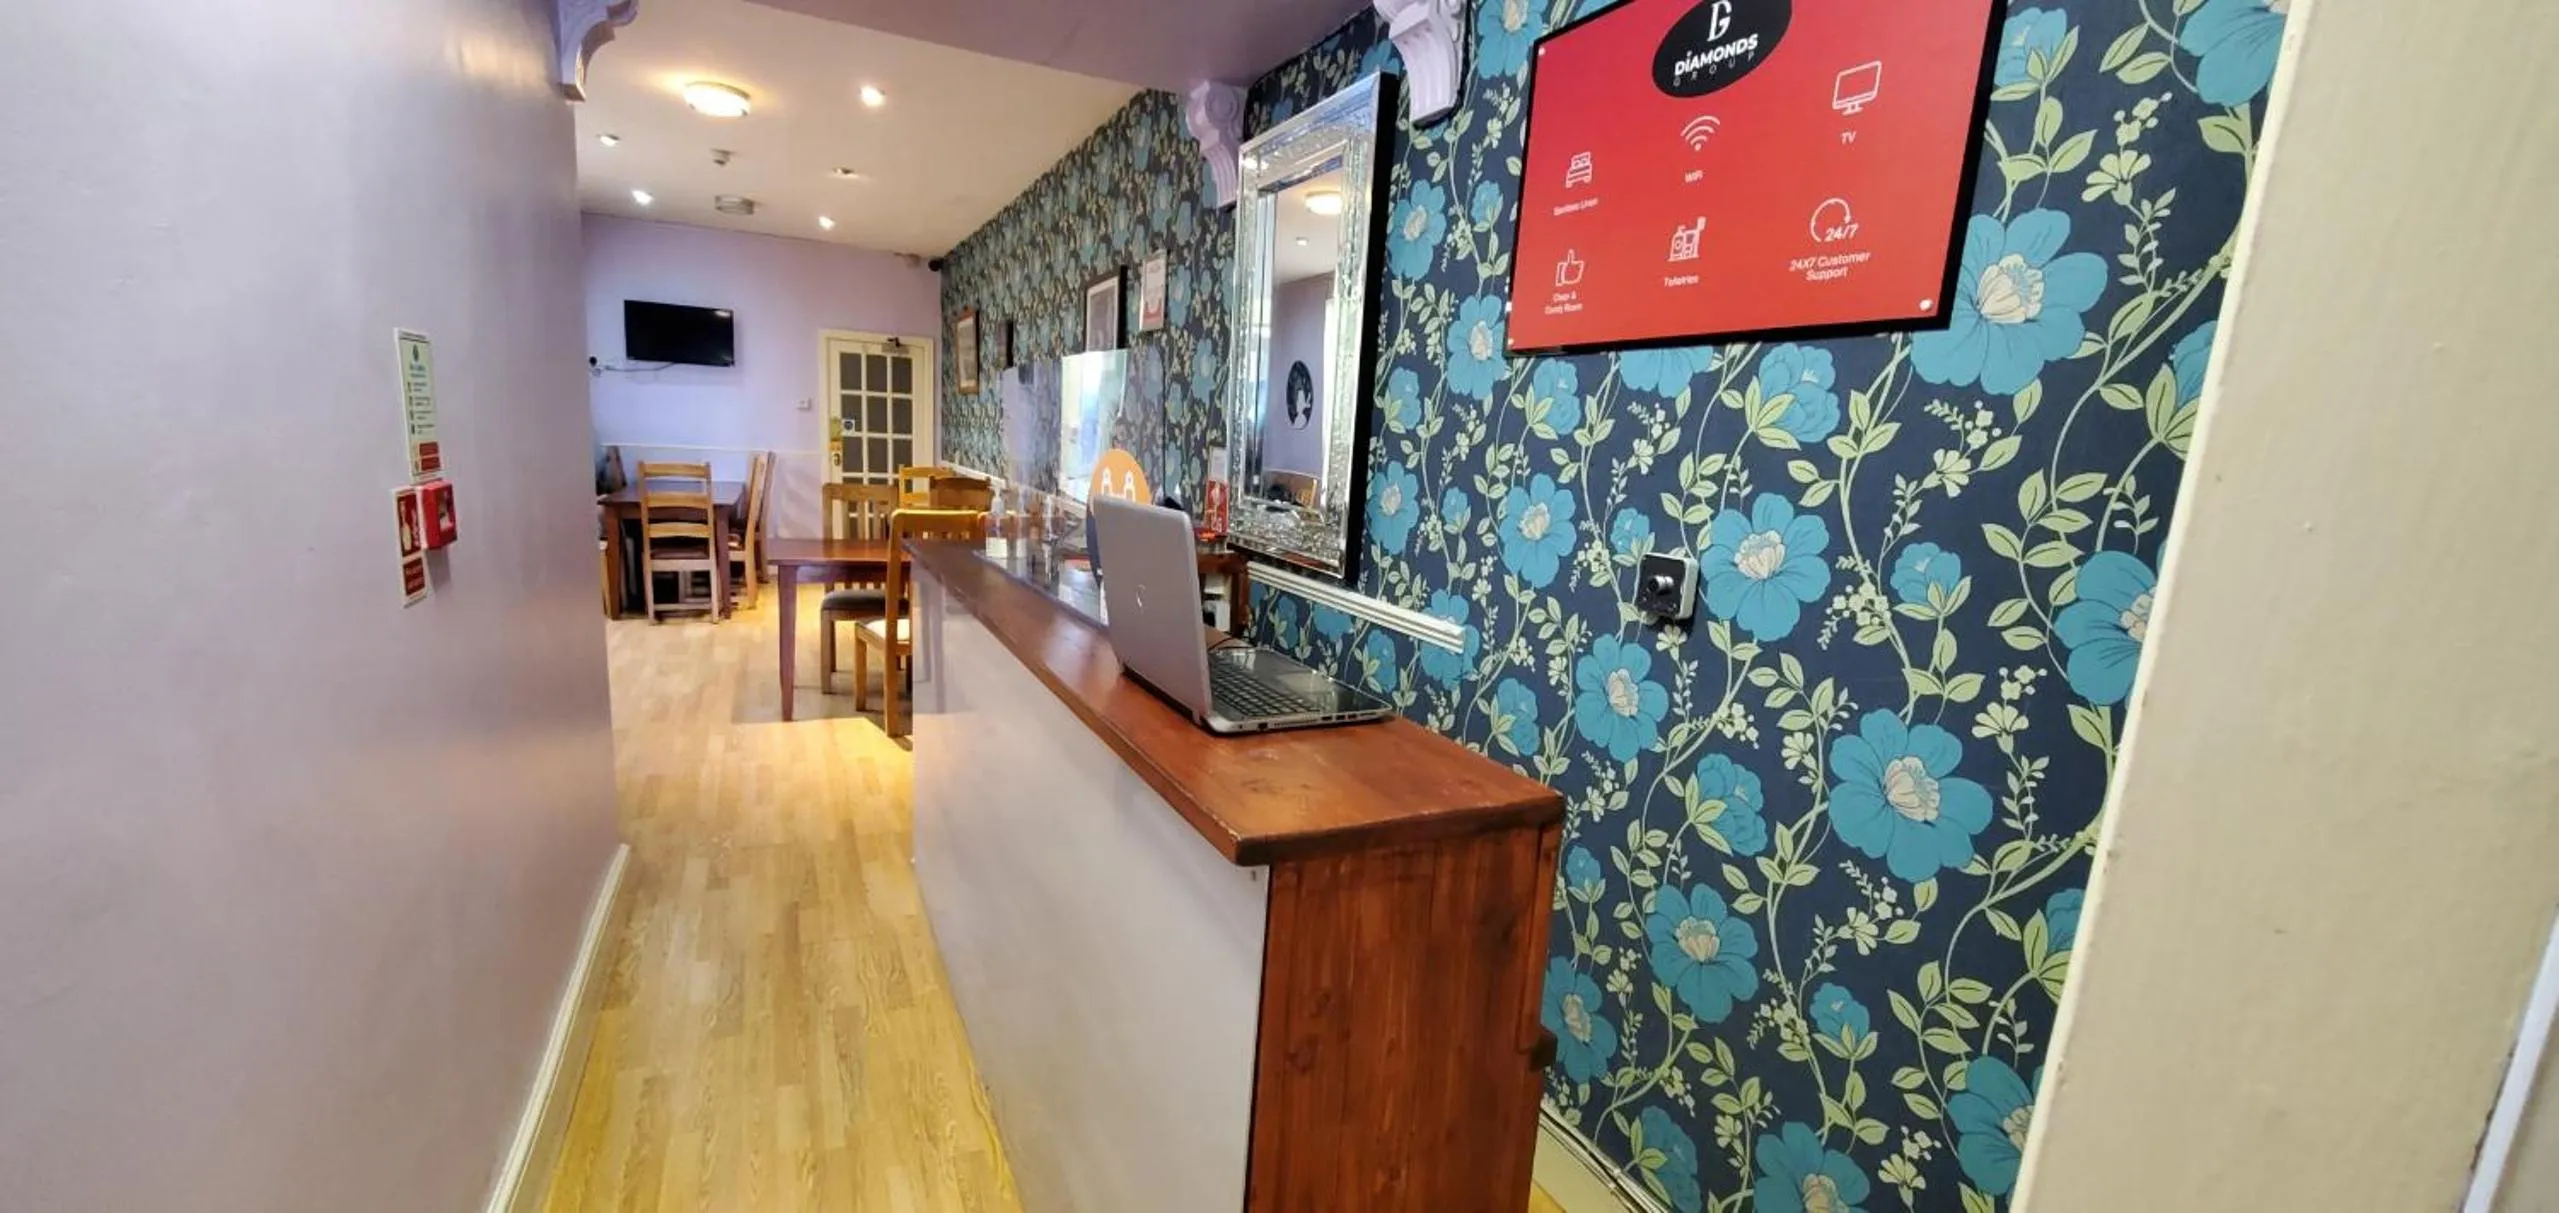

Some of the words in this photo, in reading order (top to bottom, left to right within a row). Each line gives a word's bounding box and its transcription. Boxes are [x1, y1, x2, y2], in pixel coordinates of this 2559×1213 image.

[1840, 131, 1857, 145] TV
[1823, 222, 1859, 243] 24/7
[1817, 251, 1871, 268] Customer
[1805, 266, 1848, 281] Support
